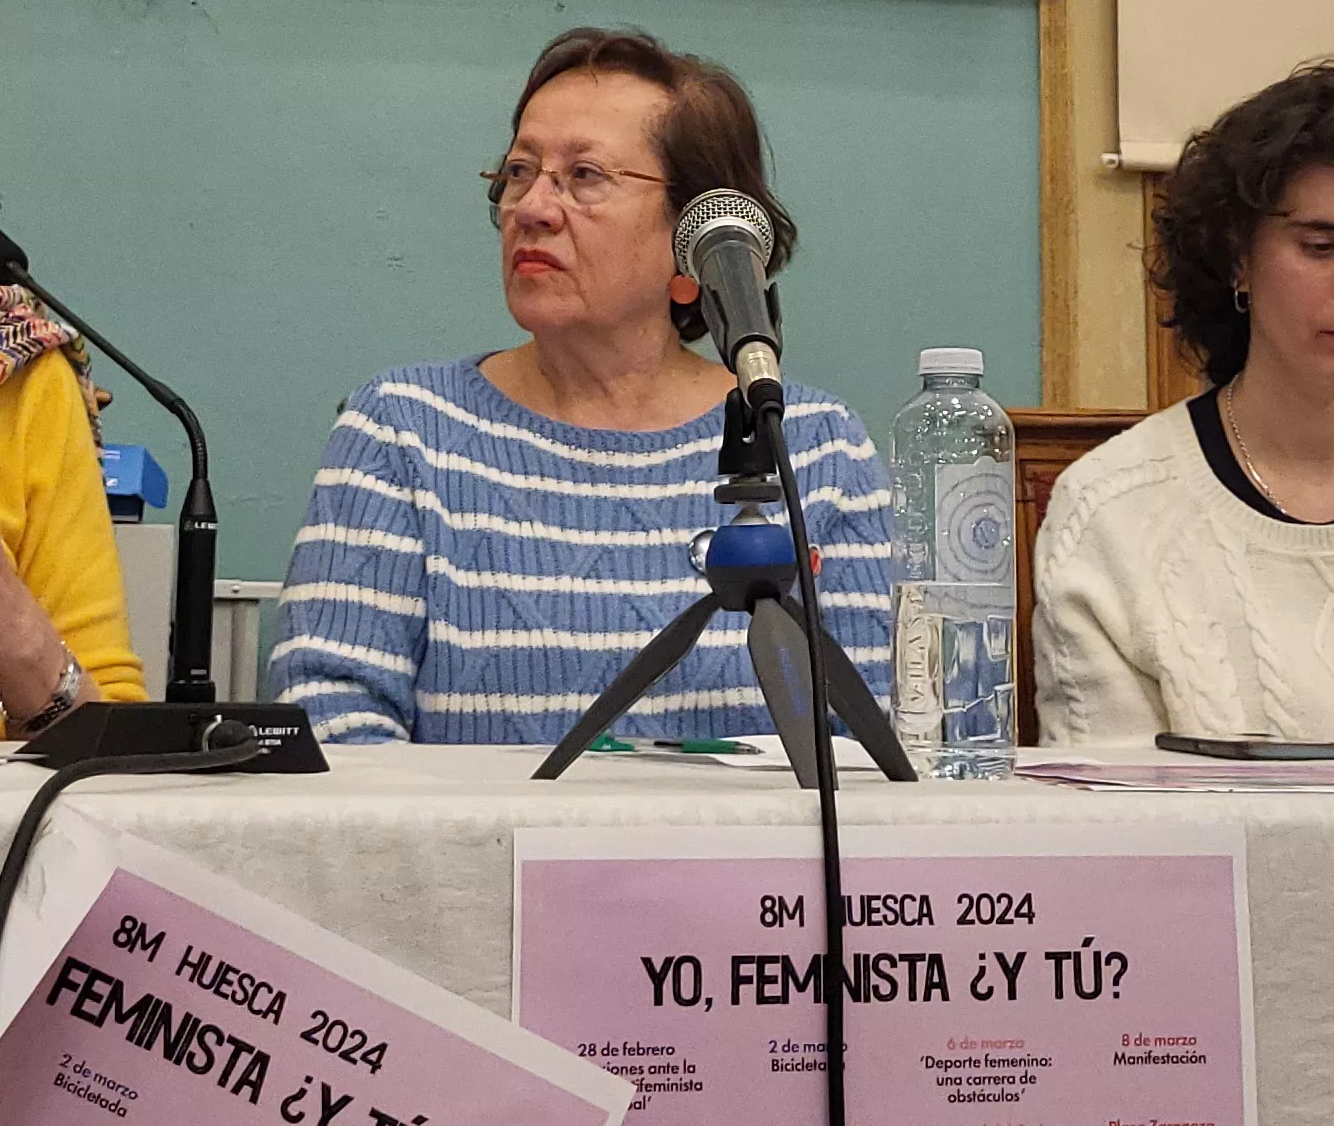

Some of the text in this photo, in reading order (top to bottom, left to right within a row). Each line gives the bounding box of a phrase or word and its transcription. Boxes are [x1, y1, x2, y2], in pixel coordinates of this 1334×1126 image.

[259, 727, 299, 736] LEWITT
[760, 894, 805, 928] 8M
[957, 892, 1036, 926] 2024
[641, 955, 714, 1013] YO,
[969, 951, 1026, 1003] ¿Y
[1045, 936, 1128, 1000] TÚ?
[112, 915, 387, 1074] 8M HUESCA 2024
[46, 956, 271, 1105] FEMINISTA
[769, 1038, 848, 1054] 2 de mao
[947, 1037, 1025, 1050] 6 de marzo
[1121, 1034, 1197, 1047] 8 de marzo
[577, 1041, 675, 1057] 28 de febrero
[771, 1057, 845, 1072] Bicicleta
[984, 1054, 1053, 1068] femenino:
[1113, 1051, 1207, 1066] Manifestación
[648, 1059, 696, 1075] ante la
[60, 1054, 139, 1100] 2 de marzo
[936, 1071, 1037, 1087] una carrera de
[53, 1072, 127, 1118] Bicicletada
